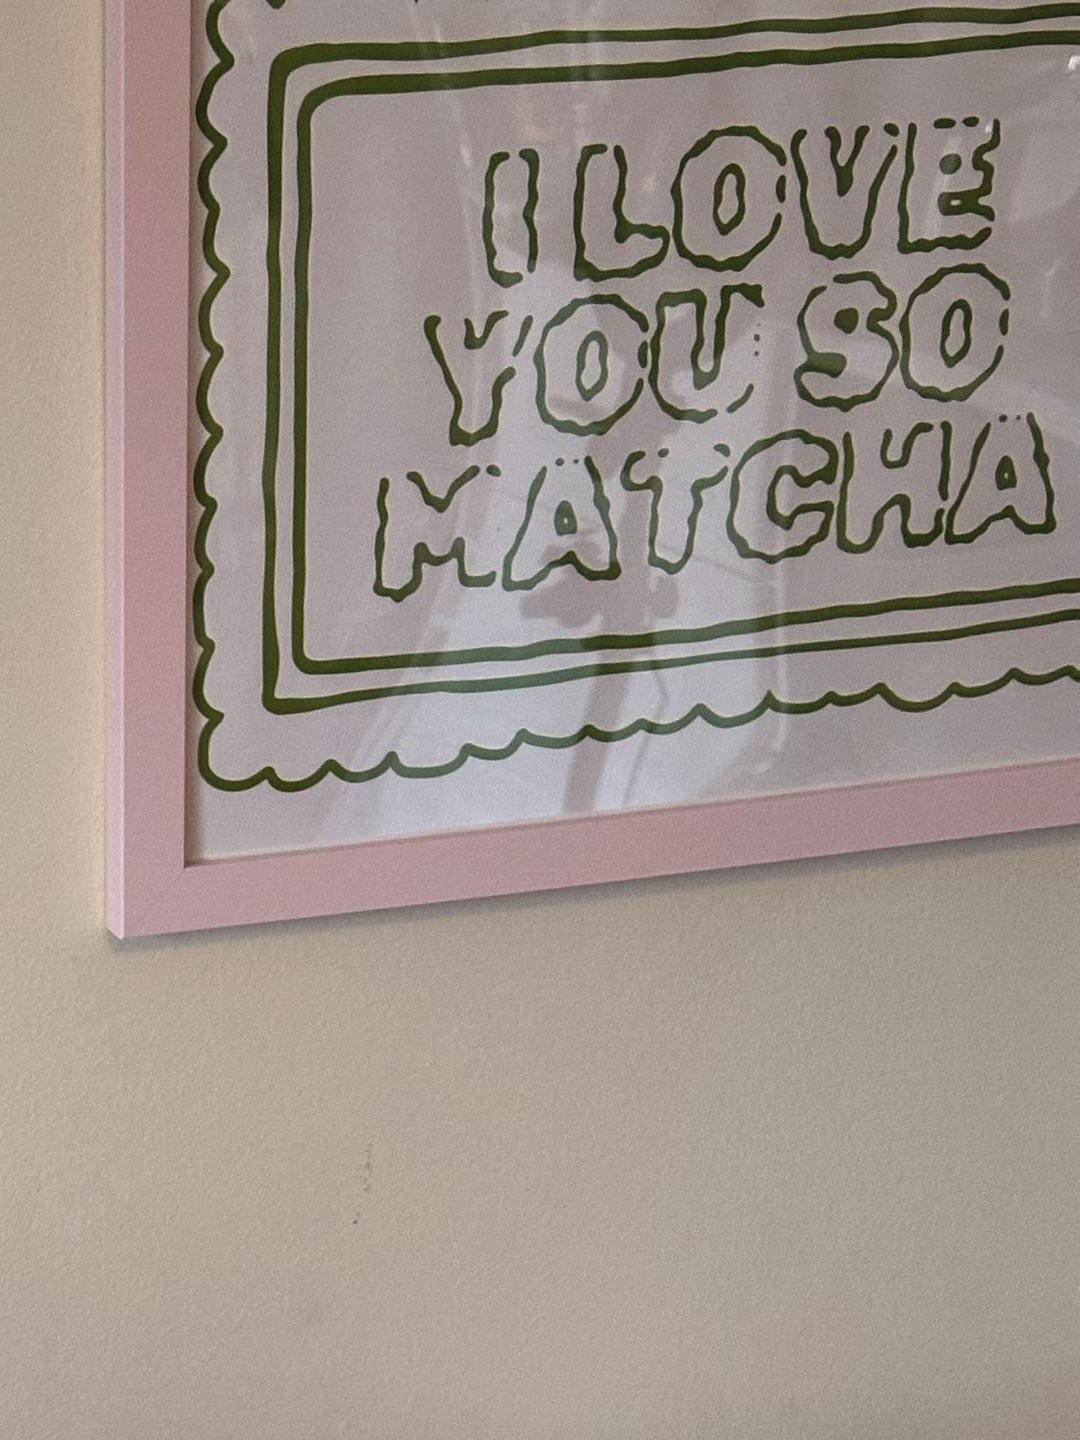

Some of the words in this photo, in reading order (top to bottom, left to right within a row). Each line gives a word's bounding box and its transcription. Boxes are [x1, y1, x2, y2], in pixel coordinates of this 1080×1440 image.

[482, 148, 540, 288] I
[573, 115, 1001, 283] LOVE
[423, 283, 765, 447] YOU
[794, 262, 1012, 413] SO
[373, 412, 1057, 603] MATCHA
